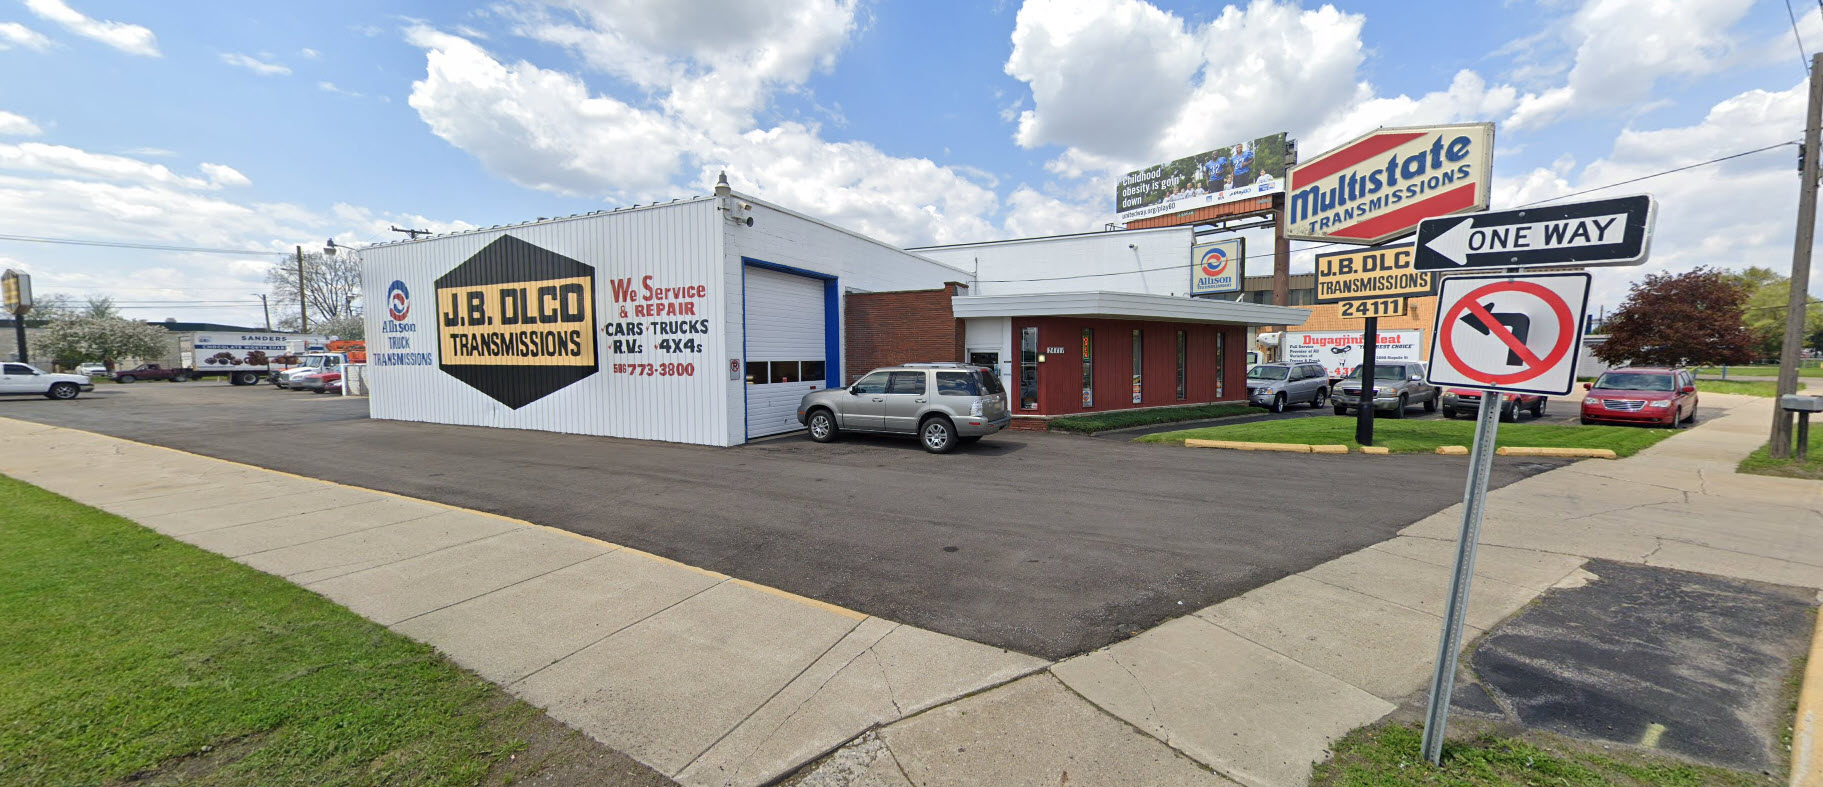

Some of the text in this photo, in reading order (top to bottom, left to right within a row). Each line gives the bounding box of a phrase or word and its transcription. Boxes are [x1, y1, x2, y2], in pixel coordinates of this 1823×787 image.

[1122, 167, 1161, 186] Childhood
[1290, 134, 1472, 225] Multistate
[1122, 182, 1150, 197] obesity
[1152, 180, 1159, 190] is
[1122, 196, 1142, 208] down
[1309, 164, 1471, 233] TRANSMISSIONS
[1122, 202, 1176, 219] unitedway.org/play60
[1468, 217, 1617, 251] ONE WAY
[1320, 251, 1411, 277] J.B. DLC
[610, 275, 706, 303] We Service
[1197, 276, 1232, 286] Allison
[1320, 271, 1428, 295] TRANSMISSIONS
[443, 283, 585, 327] J.B. DLCO
[619, 301, 696, 318] & REPAIR
[1341, 299, 1399, 317] 24111
[382, 320, 416, 333] Allison
[605, 319, 709, 336] CARS TRUCKS
[388, 336, 410, 350] TRUCK
[450, 330, 581, 357] TRANSMISSIONS
[1303, 335, 1363, 347] Dugagjini
[373, 353, 433, 366] TRANSMISSIONS
[627, 362, 695, 376] 773-3800
